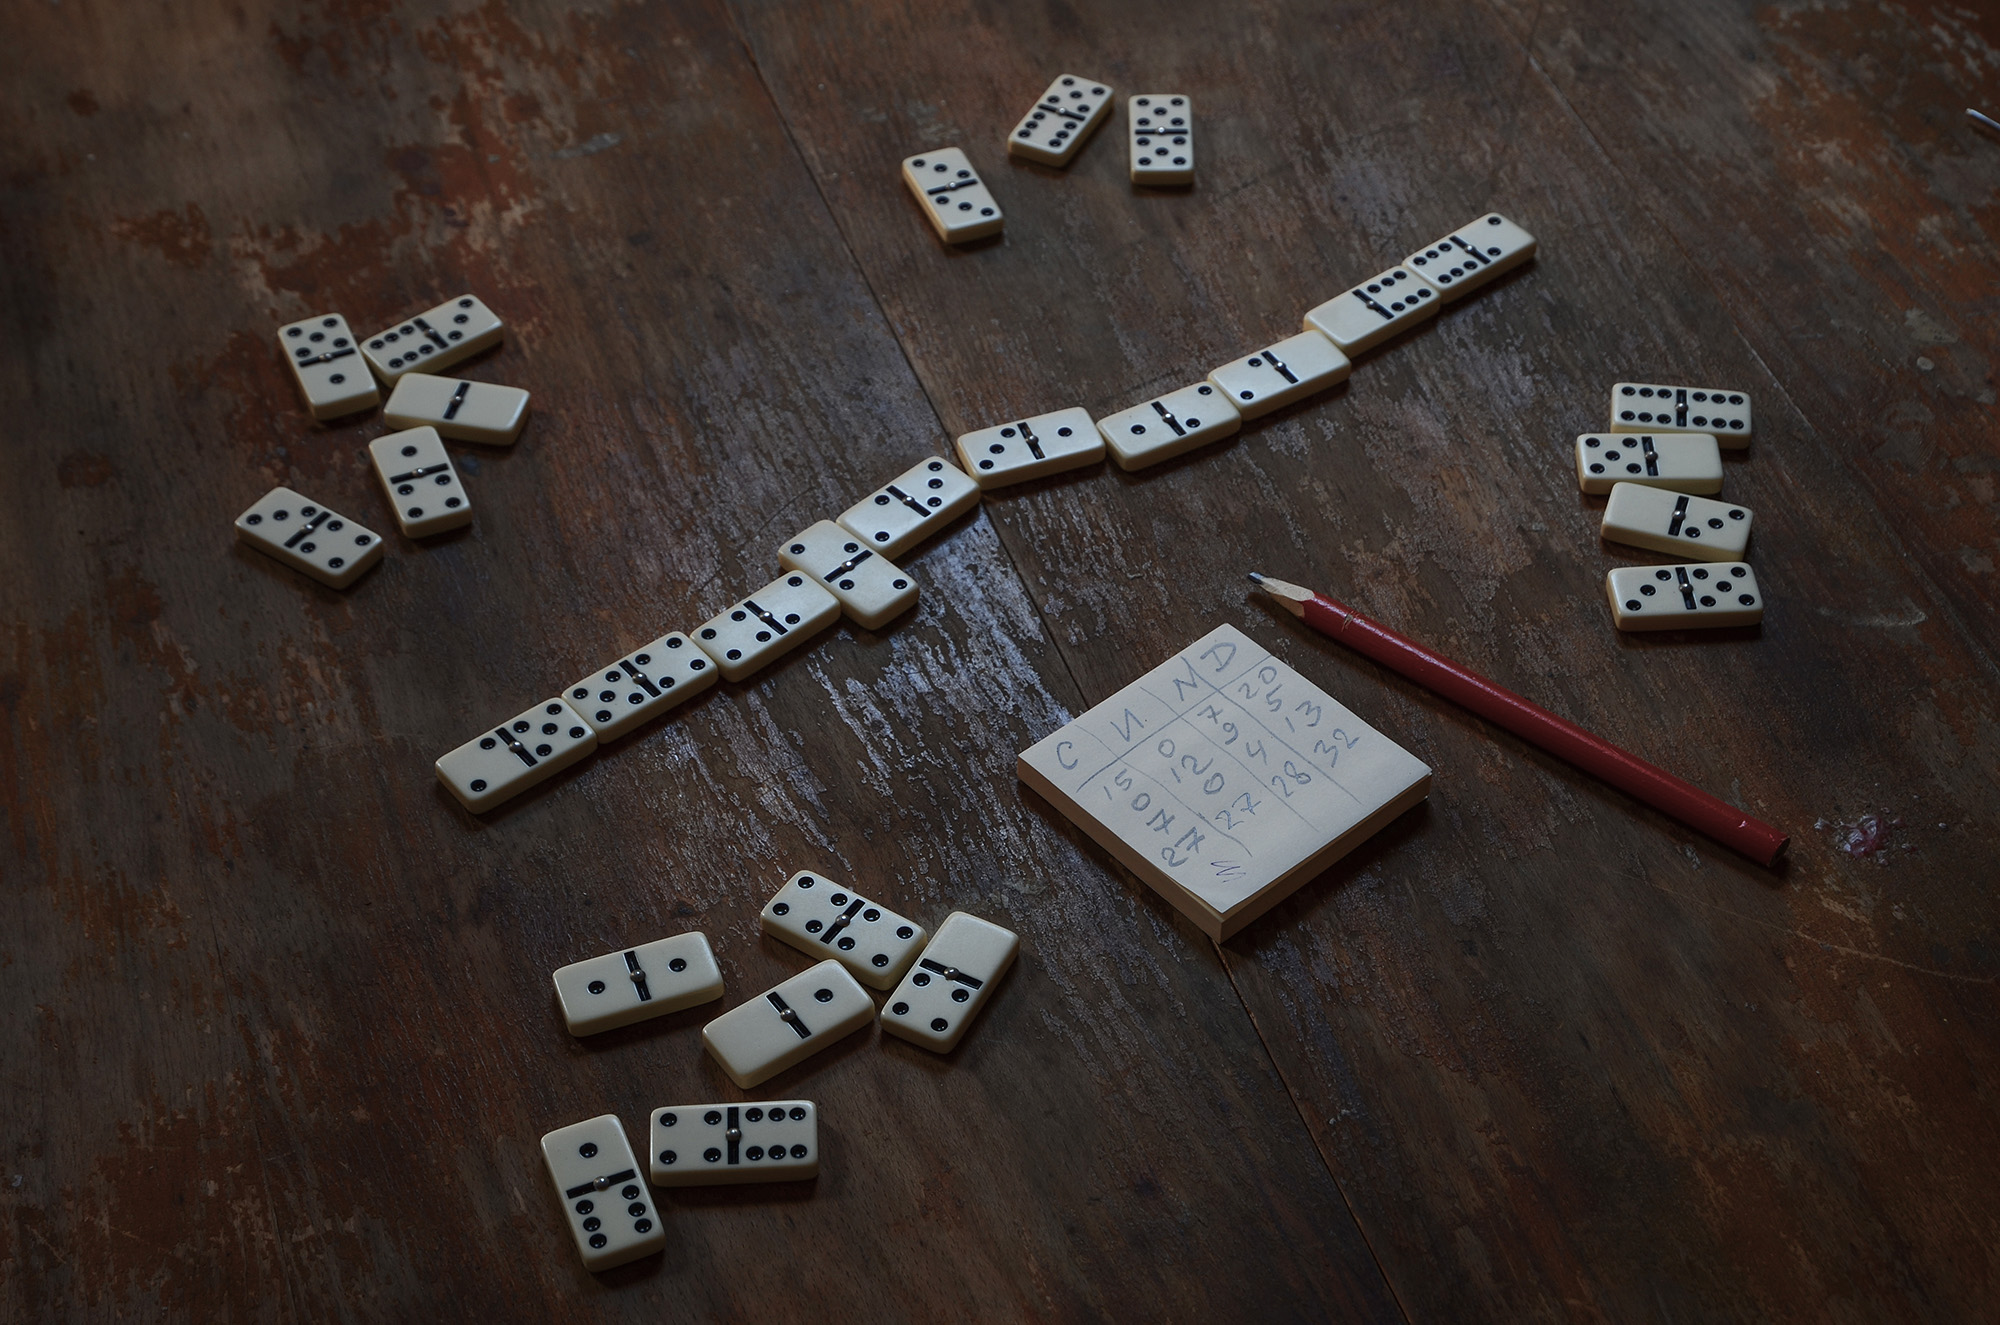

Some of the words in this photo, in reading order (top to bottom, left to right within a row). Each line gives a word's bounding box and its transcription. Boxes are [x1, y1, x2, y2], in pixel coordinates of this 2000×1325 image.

[1200, 642, 1236, 671] D
[1104, 769, 1132, 800] 15
[1159, 739, 1175, 758] 0
[1198, 705, 1224, 723] 7
[1238, 666, 1278, 699] 20
[1131, 793, 1150, 811] 0
[1171, 755, 1213, 783] 12
[1223, 722, 1239, 745] 9
[1265, 685, 1282, 712] 5
[1204, 773, 1224, 794] 0
[1247, 740, 1268, 765] 4
[1286, 701, 1322, 732] 13
[1161, 827, 1205, 867] 27
[1216, 792, 1262, 830] 27
[1272, 761, 1310, 798] 28
[1314, 728, 1359, 767] 32
